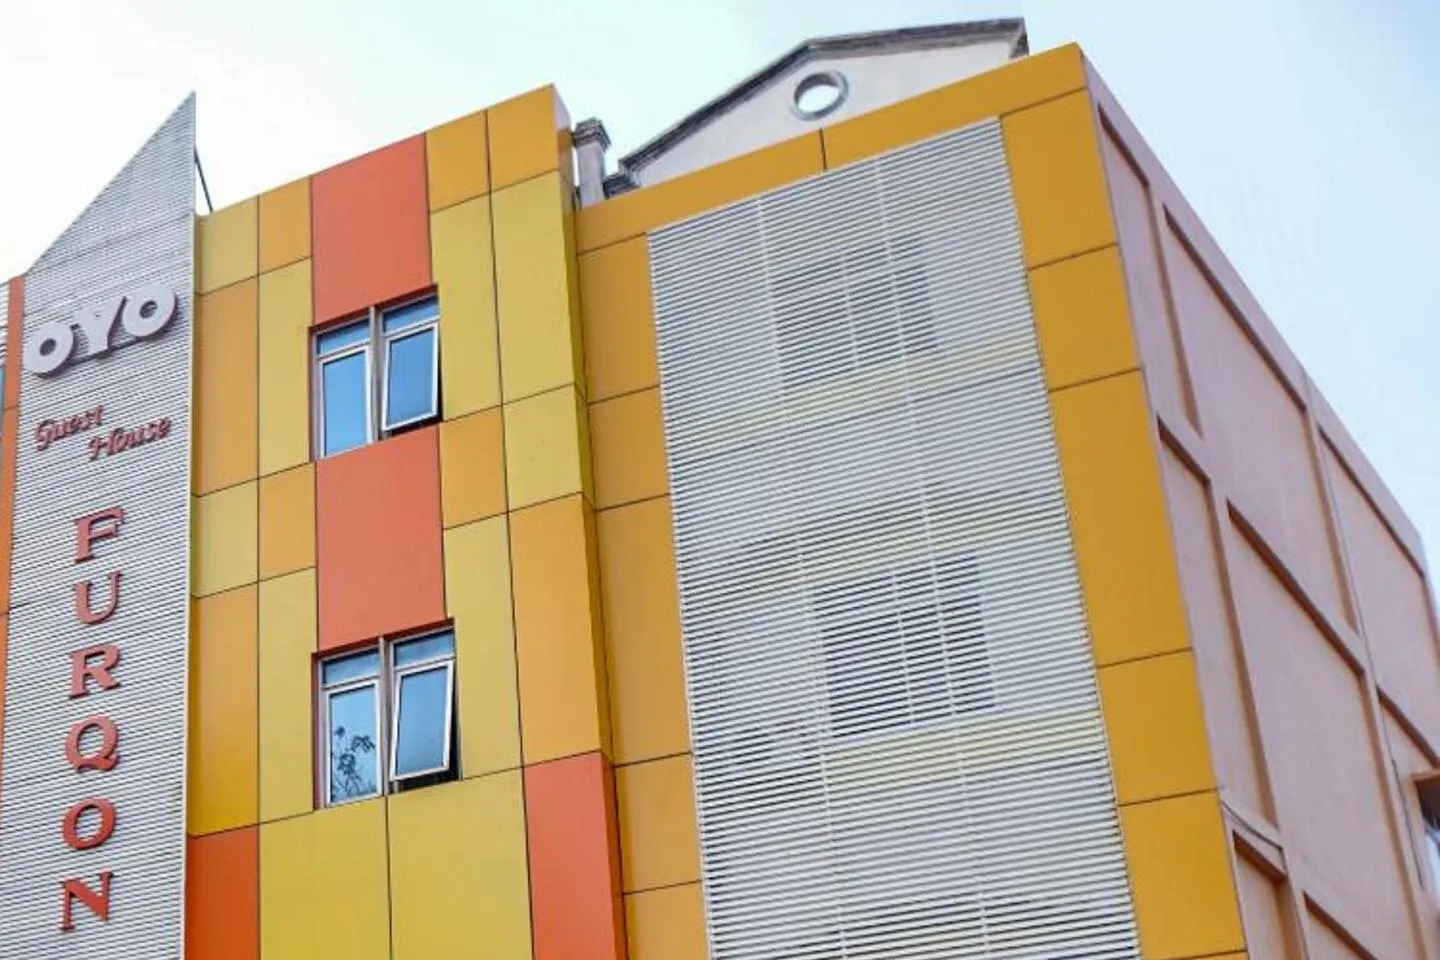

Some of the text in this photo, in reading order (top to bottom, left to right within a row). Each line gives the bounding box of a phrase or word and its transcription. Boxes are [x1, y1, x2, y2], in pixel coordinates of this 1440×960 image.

[23, 283, 178, 378] OYO
[35, 404, 105, 452] Guest
[88, 416, 173, 462] House
[59, 506, 127, 932] FURQON
